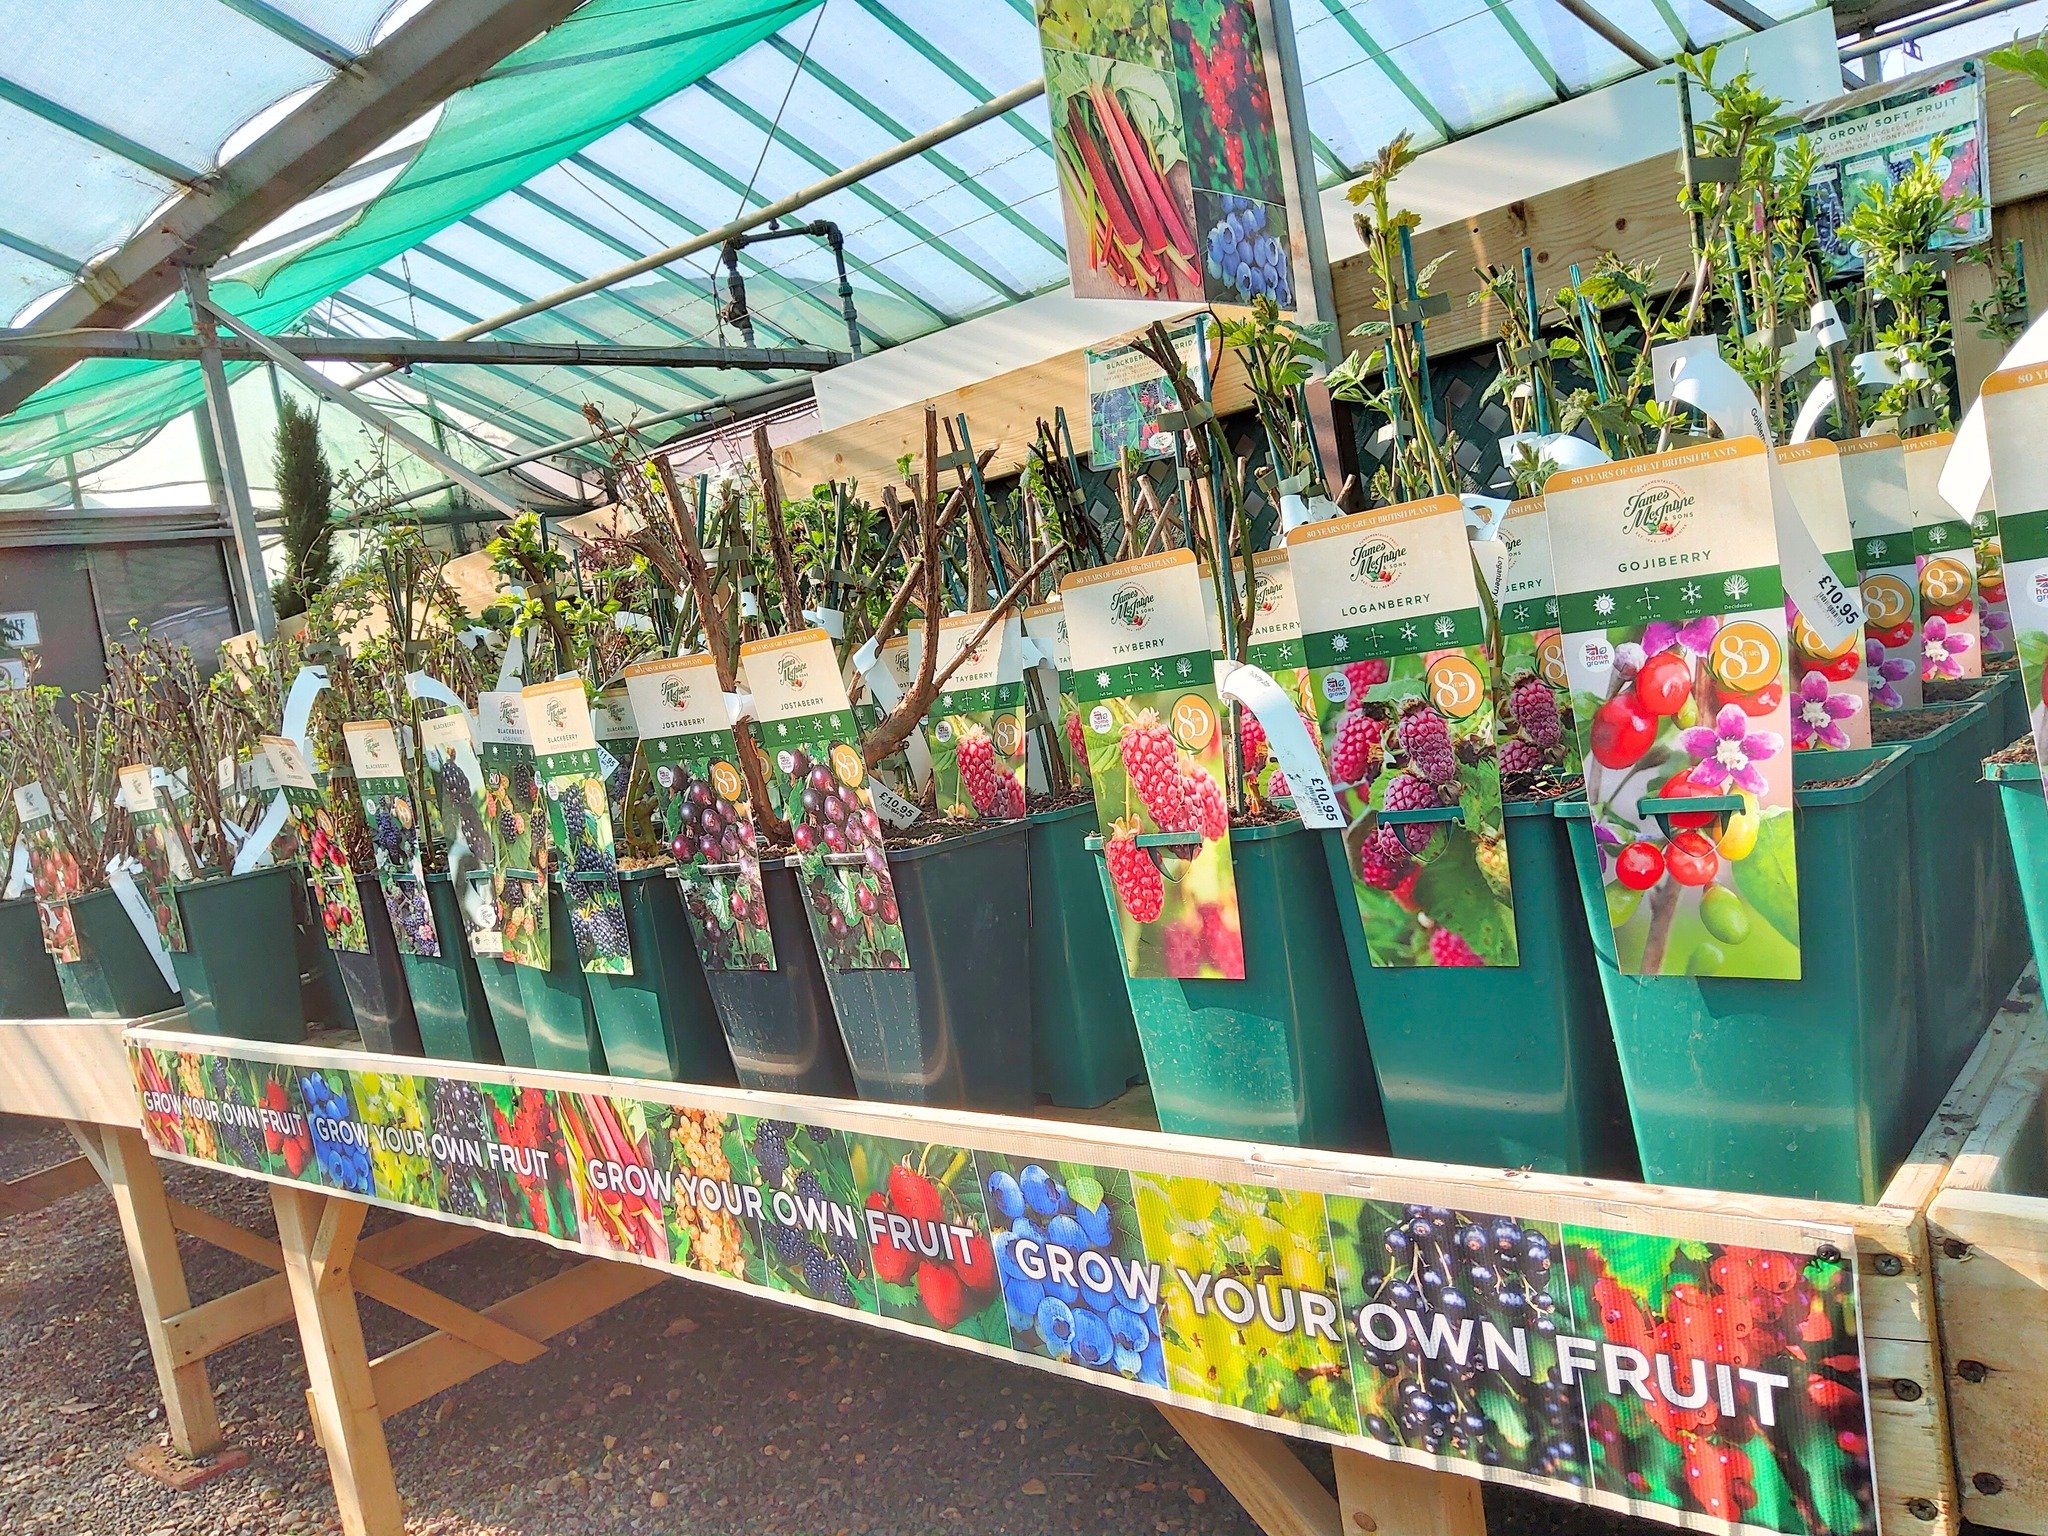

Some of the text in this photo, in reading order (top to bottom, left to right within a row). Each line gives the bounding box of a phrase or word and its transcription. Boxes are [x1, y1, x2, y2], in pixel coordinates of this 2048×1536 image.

[1830, 96, 1958, 140] GROW SOFT FRUIT
[2018, 373, 2033, 384] 80
[1778, 447, 1812, 462] PLANTS
[1848, 441, 1879, 453] PLANTS
[1909, 439, 1937, 451] PLANTS
[1571, 446, 1737, 486] 80 YEARS OF GREAT BRITISH PLANTS
[1622, 495, 1695, 535] McIntyre
[1624, 489, 1669, 518] James
[1306, 503, 1437, 539] 80 YEARS OF GREAT BRITISH PLANTS
[1673, 512, 1694, 521] SONS
[1350, 542, 1386, 567] James
[1389, 561, 1407, 569] SONS
[1618, 550, 1712, 573] GOJIBERRY
[1084, 573, 1103, 583] YEARS
[1103, 571, 1111, 579] OF
[1112, 567, 1131, 577] GREAT
[1131, 562, 1155, 573] BRITISH
[1155, 556, 1177, 567] PLANTS
[1341, 593, 1431, 617] LOGANBERRY
[1685, 607, 1702, 615] Hardy
[1724, 602, 1753, 610] Deciduous
[1818, 575, 1859, 625] £10.95
[1112, 638, 1165, 655] TAYBERRY
[1585, 654, 1609, 662] home
[1720, 635, 1770, 680] 80
[1586, 659, 1609, 668] grown
[955, 672, 993, 683] TAYBERRY
[1434, 668, 1476, 707] 80
[781, 697, 824, 711] JOSTABERRY
[662, 718, 706, 730] JOSTABERRY
[1177, 704, 1209, 740] 80
[547, 734, 578, 743] BLACKBERRY
[489, 773, 499, 784] 80
[836, 752, 859, 780] 80
[715, 768, 737, 795] 80
[879, 792, 915, 819] £10.95
[1311, 778, 1339, 821] £10.95
[143, 1091, 303, 1137] GROW YOUR OWN FRUIT
[315, 1117, 550, 1180] GROW YOUR OWN FRUIT
[588, 1159, 975, 1266] GROW YOUR OWN FRUIT
[1014, 1237, 1791, 1428] GROW YOUR OWN FRUIT
